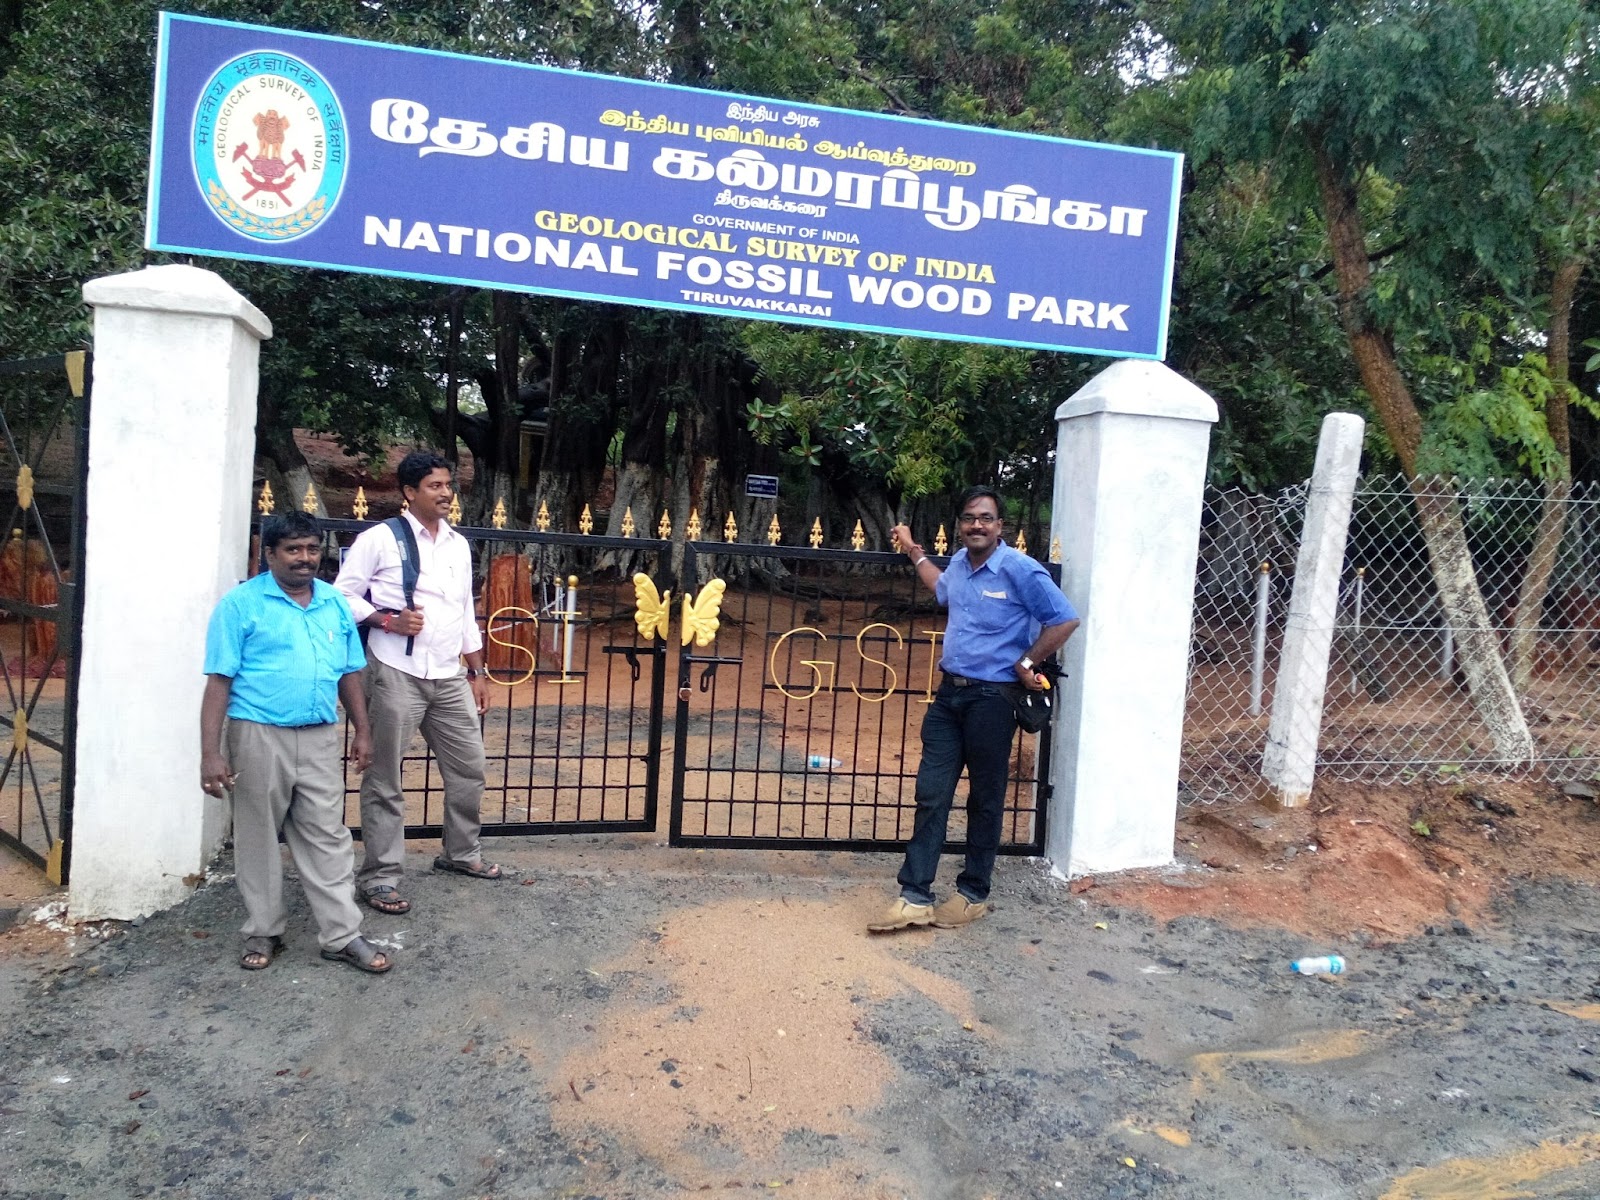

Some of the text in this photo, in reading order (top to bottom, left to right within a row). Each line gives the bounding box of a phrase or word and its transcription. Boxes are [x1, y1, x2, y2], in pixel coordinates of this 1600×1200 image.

[216, 77, 323, 171] GEOLOGICAL SURVEY OF INDIA
[599, 109, 977, 177] இந்திய புவியியல் ஆய்வுத்துறை
[725, 102, 821, 128] இந்திய அரசு
[369, 97, 1149, 237] தேசிய கல்மரப்பூங்கா
[714, 188, 828, 218] திருவக்கரை
[256, 199, 279, 209] 1851
[692, 213, 860, 244] GOVERNMENT OF INDIA
[363, 215, 1131, 332] NATIONAL FOSSIL WOOD PARK
[534, 209, 996, 285] GEOLOGICAL SURVEY OF INDIA
[680, 289, 832, 317] TIRUVAKKARAI
[460, 606, 582, 685] SI
[770, 622, 945, 703] GSI
